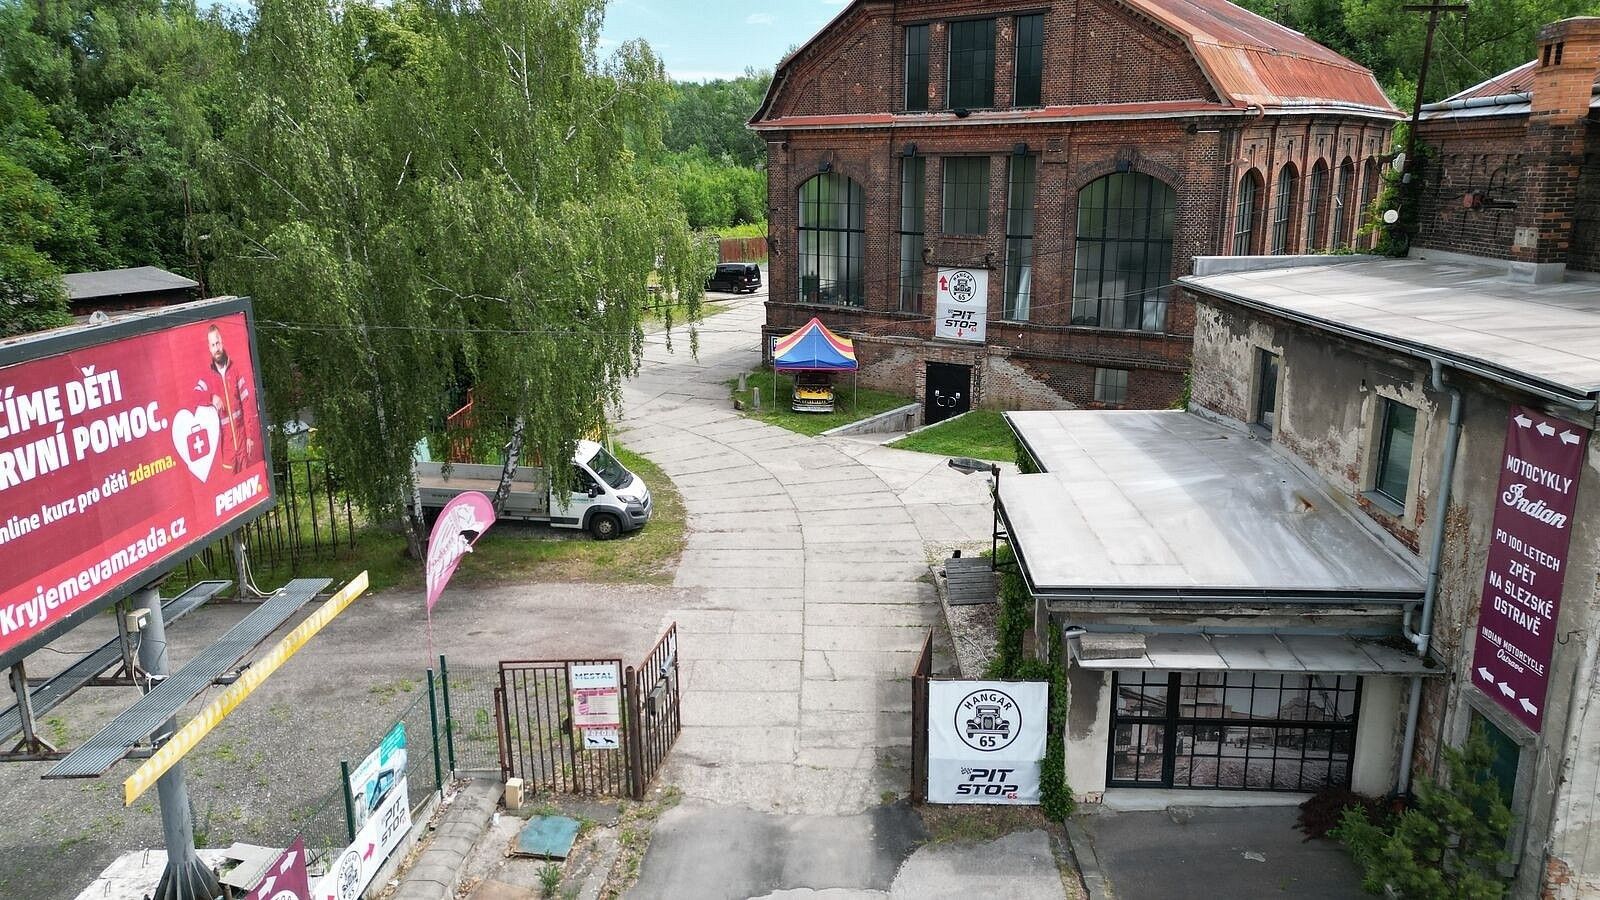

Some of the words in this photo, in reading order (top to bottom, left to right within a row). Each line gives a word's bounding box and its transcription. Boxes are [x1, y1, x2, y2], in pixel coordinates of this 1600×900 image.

[953, 273, 973, 282] HANGAR
[945, 320, 978, 328] STOP
[952, 310, 976, 320] PIT
[65, 364, 122, 416] DĚTI
[0, 421, 70, 491] RVNÍ
[72, 401, 168, 461] POMOC.
[41, 498, 77, 525] kurz
[77, 487, 101, 514] pro
[102, 469, 129, 498] děti
[129, 455, 177, 486] zdarma.
[1506, 454, 1573, 495] MOTOCYKLY
[1502, 483, 1567, 529] Indian
[1496, 528, 1507, 544] PO
[1508, 537, 1522, 553] 100
[1523, 543, 1561, 572] LETECH
[0, 517, 188, 636] Kryjemevamzada.cz
[1509, 559, 1537, 586] ZPĚT
[1489, 570, 1502, 590] NA
[1504, 579, 1554, 620] SLEZSKÉ
[1493, 595, 1542, 636] OSTRAVĚ
[1481, 626, 1503, 646] INDIAN
[1502, 640, 1545, 674] MOTORCYCLE
[1496, 648, 1525, 674] Ostrava
[964, 693, 1012, 711] HANGAR
[979, 735, 996, 747] 65
[955, 784, 1019, 796] STOP
[968, 768, 1015, 782] PIT
[381, 807, 405, 848] STOP
[384, 796, 401, 828] PIT
